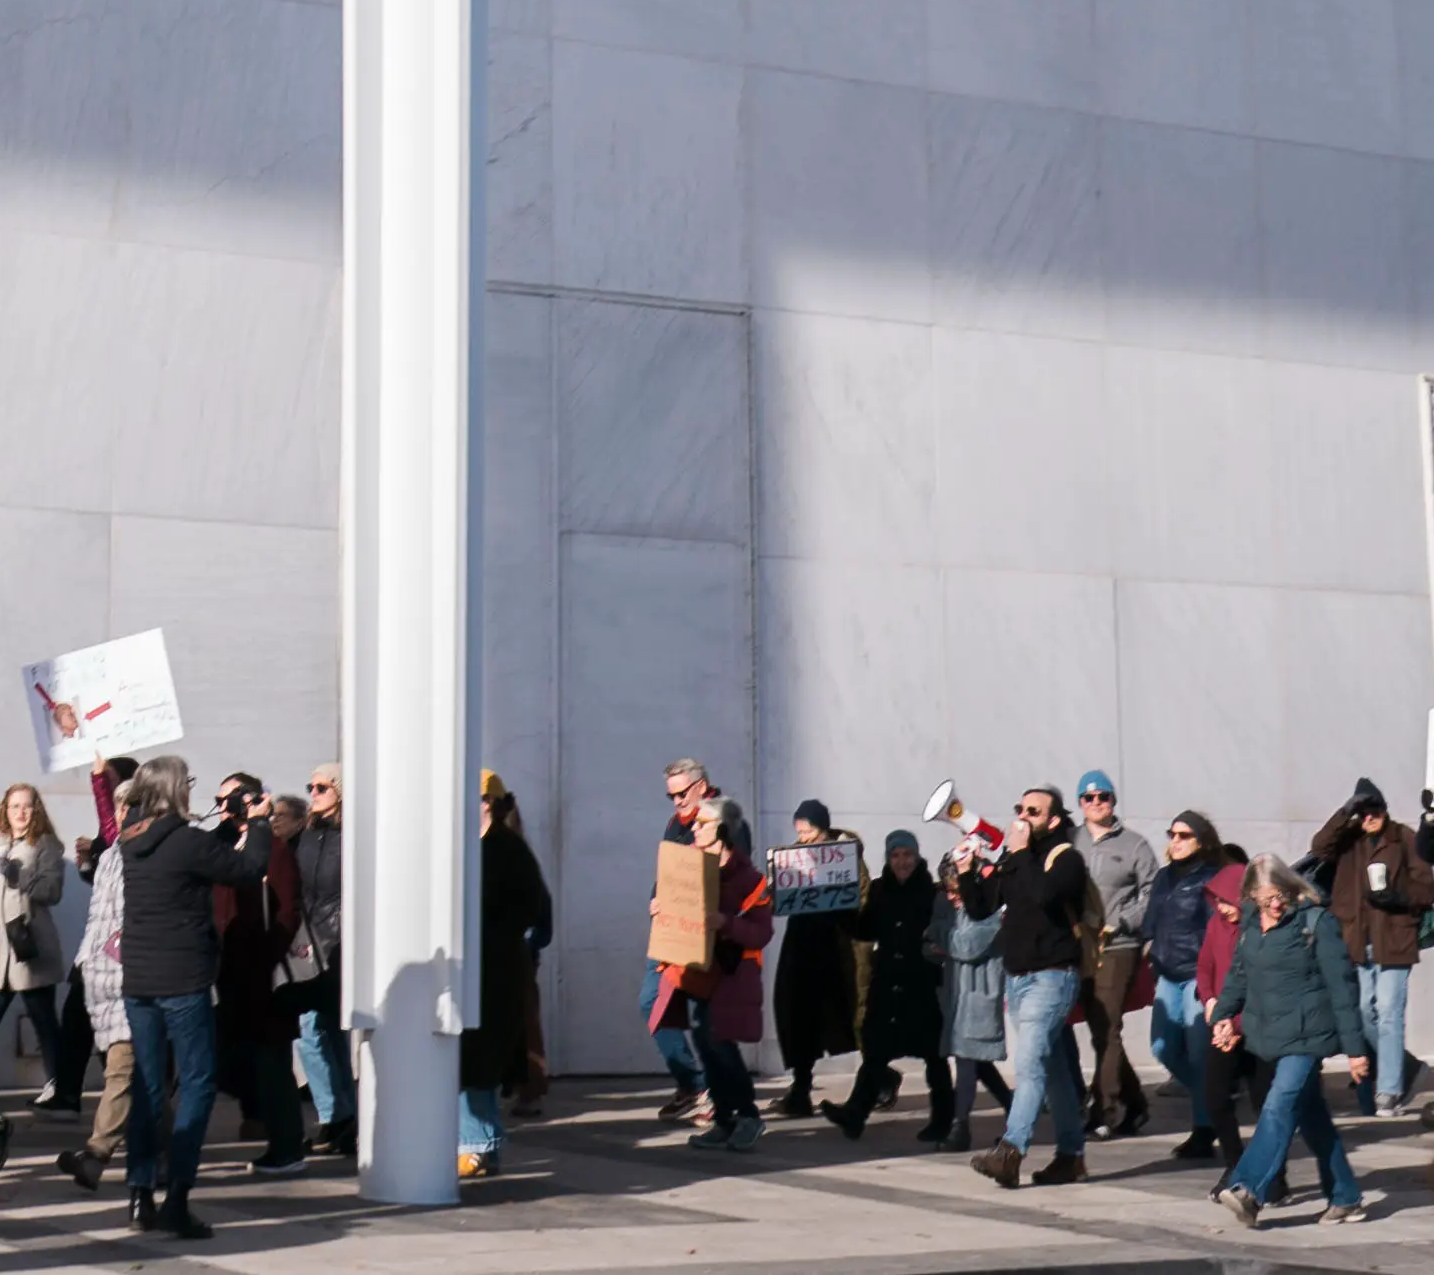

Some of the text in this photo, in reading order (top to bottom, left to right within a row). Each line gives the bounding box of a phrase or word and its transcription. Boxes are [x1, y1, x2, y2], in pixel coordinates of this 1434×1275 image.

[777, 845, 845, 870] HANDS
[778, 867, 851, 889] OFF THE
[778, 880, 860, 914] ARTS
